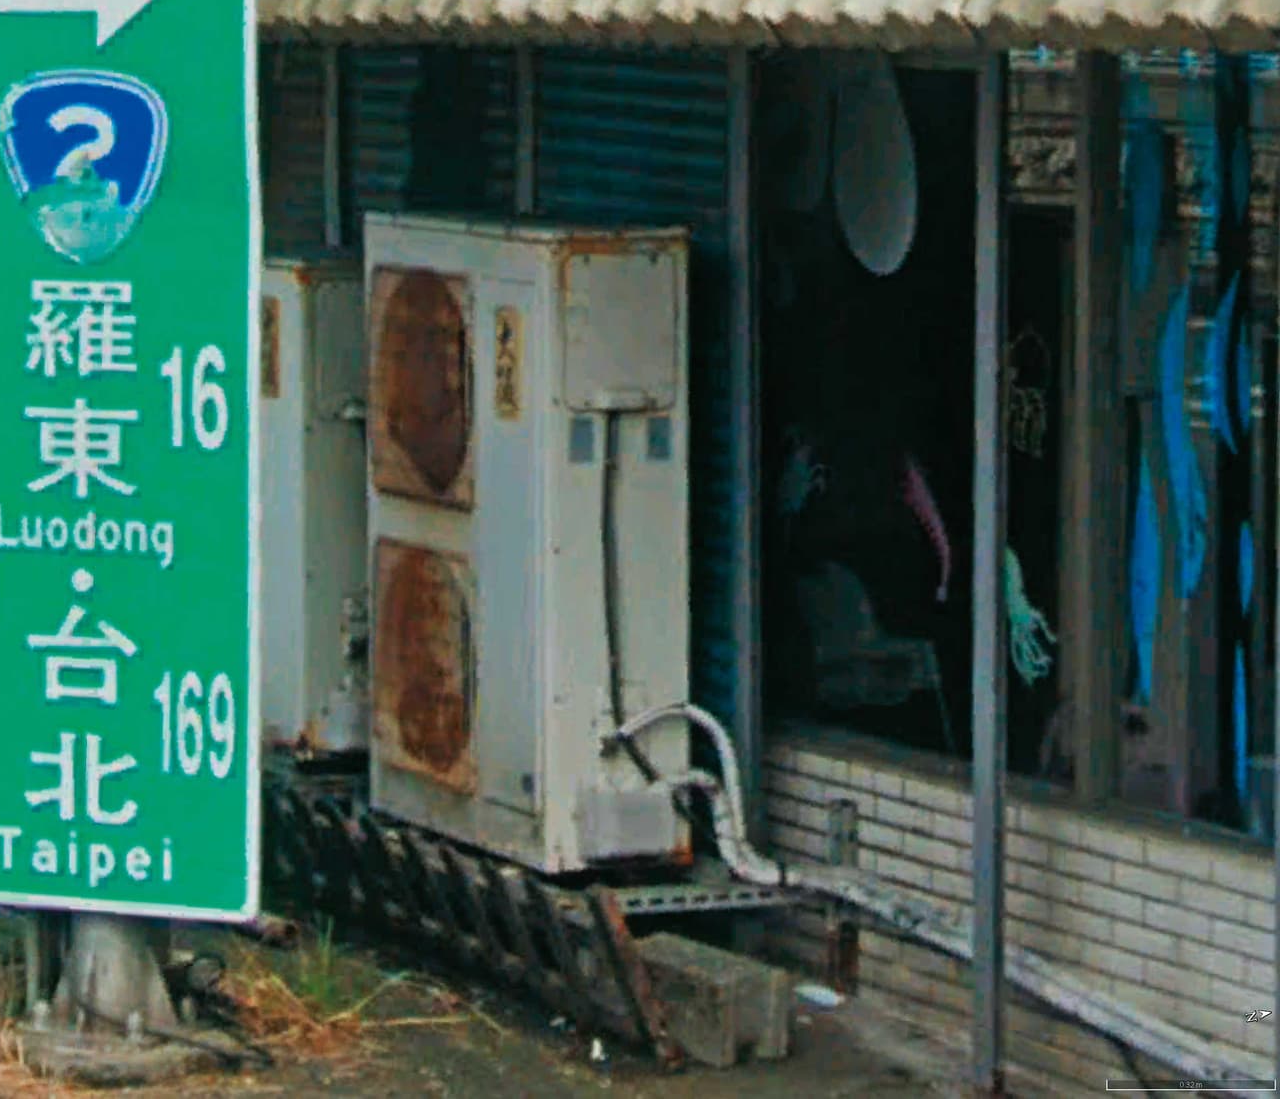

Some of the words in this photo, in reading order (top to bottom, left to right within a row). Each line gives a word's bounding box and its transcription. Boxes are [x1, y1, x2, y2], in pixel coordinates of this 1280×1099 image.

[24, 279, 139, 499] 羅東
[160, 344, 229, 451] 16
[24, 604, 139, 826] 台北
[153, 671, 236, 779] 169
